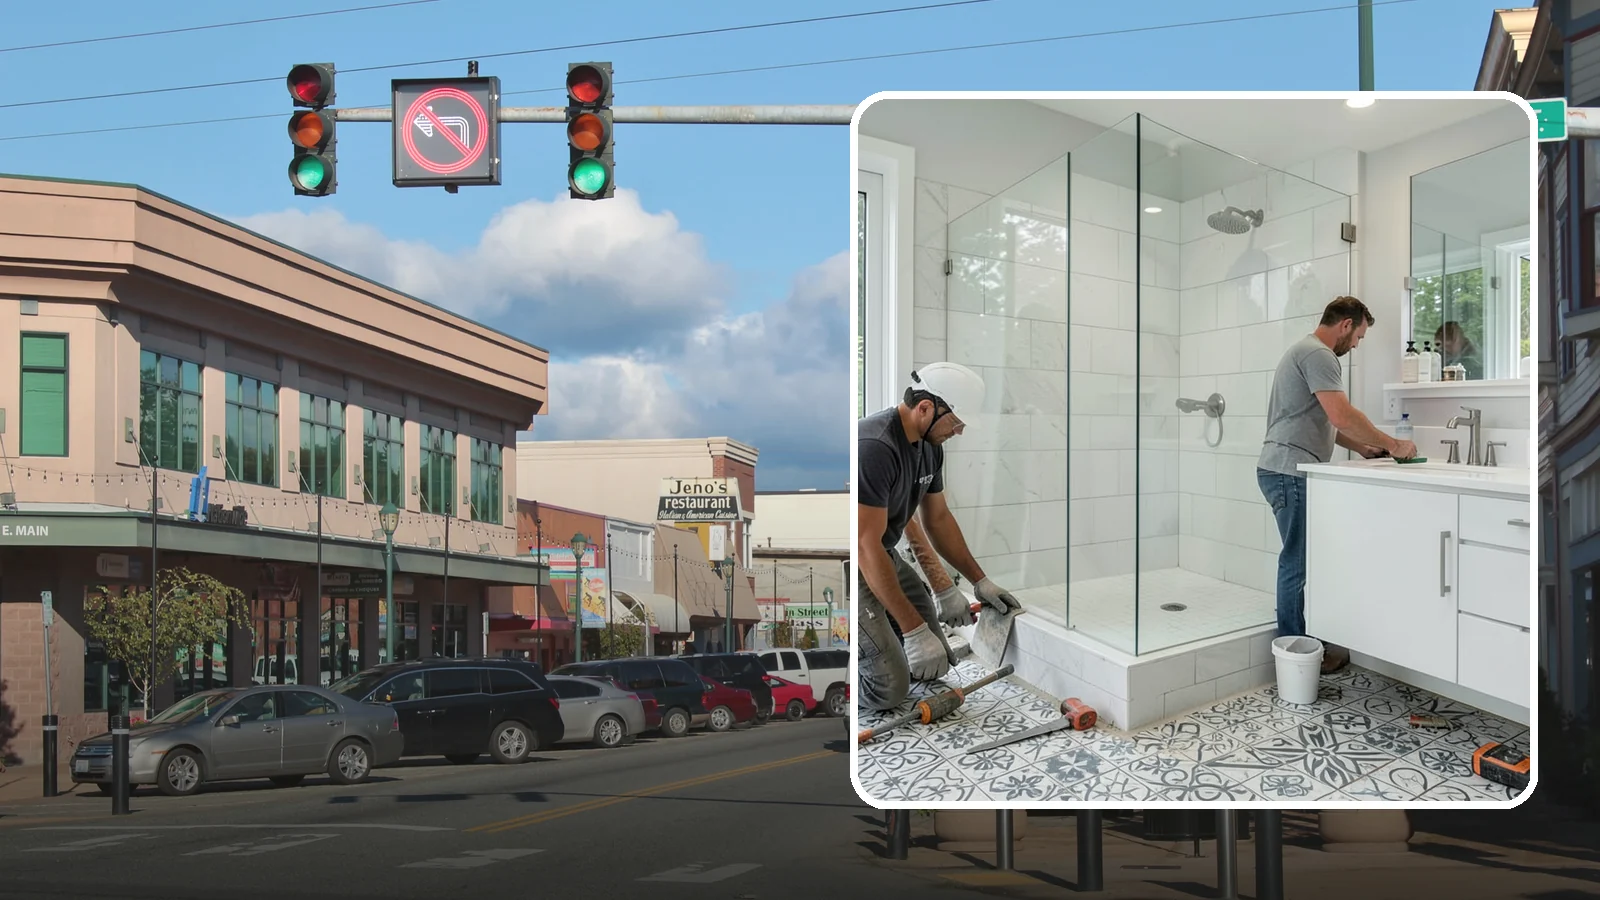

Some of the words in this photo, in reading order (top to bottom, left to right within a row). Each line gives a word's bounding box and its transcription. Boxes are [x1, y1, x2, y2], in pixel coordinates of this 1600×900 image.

[670, 480, 727, 494] Jeno's
[665, 496, 731, 509] restaurant
[659, 510, 681, 519] Italian
[686, 510, 714, 519] American
[715, 510, 737, 519] Cuisine
[2, 525, 13, 536] E.
[15, 525, 49, 536] MAIN
[797, 607, 828, 616] Street
[791, 619, 823, 627] lass
